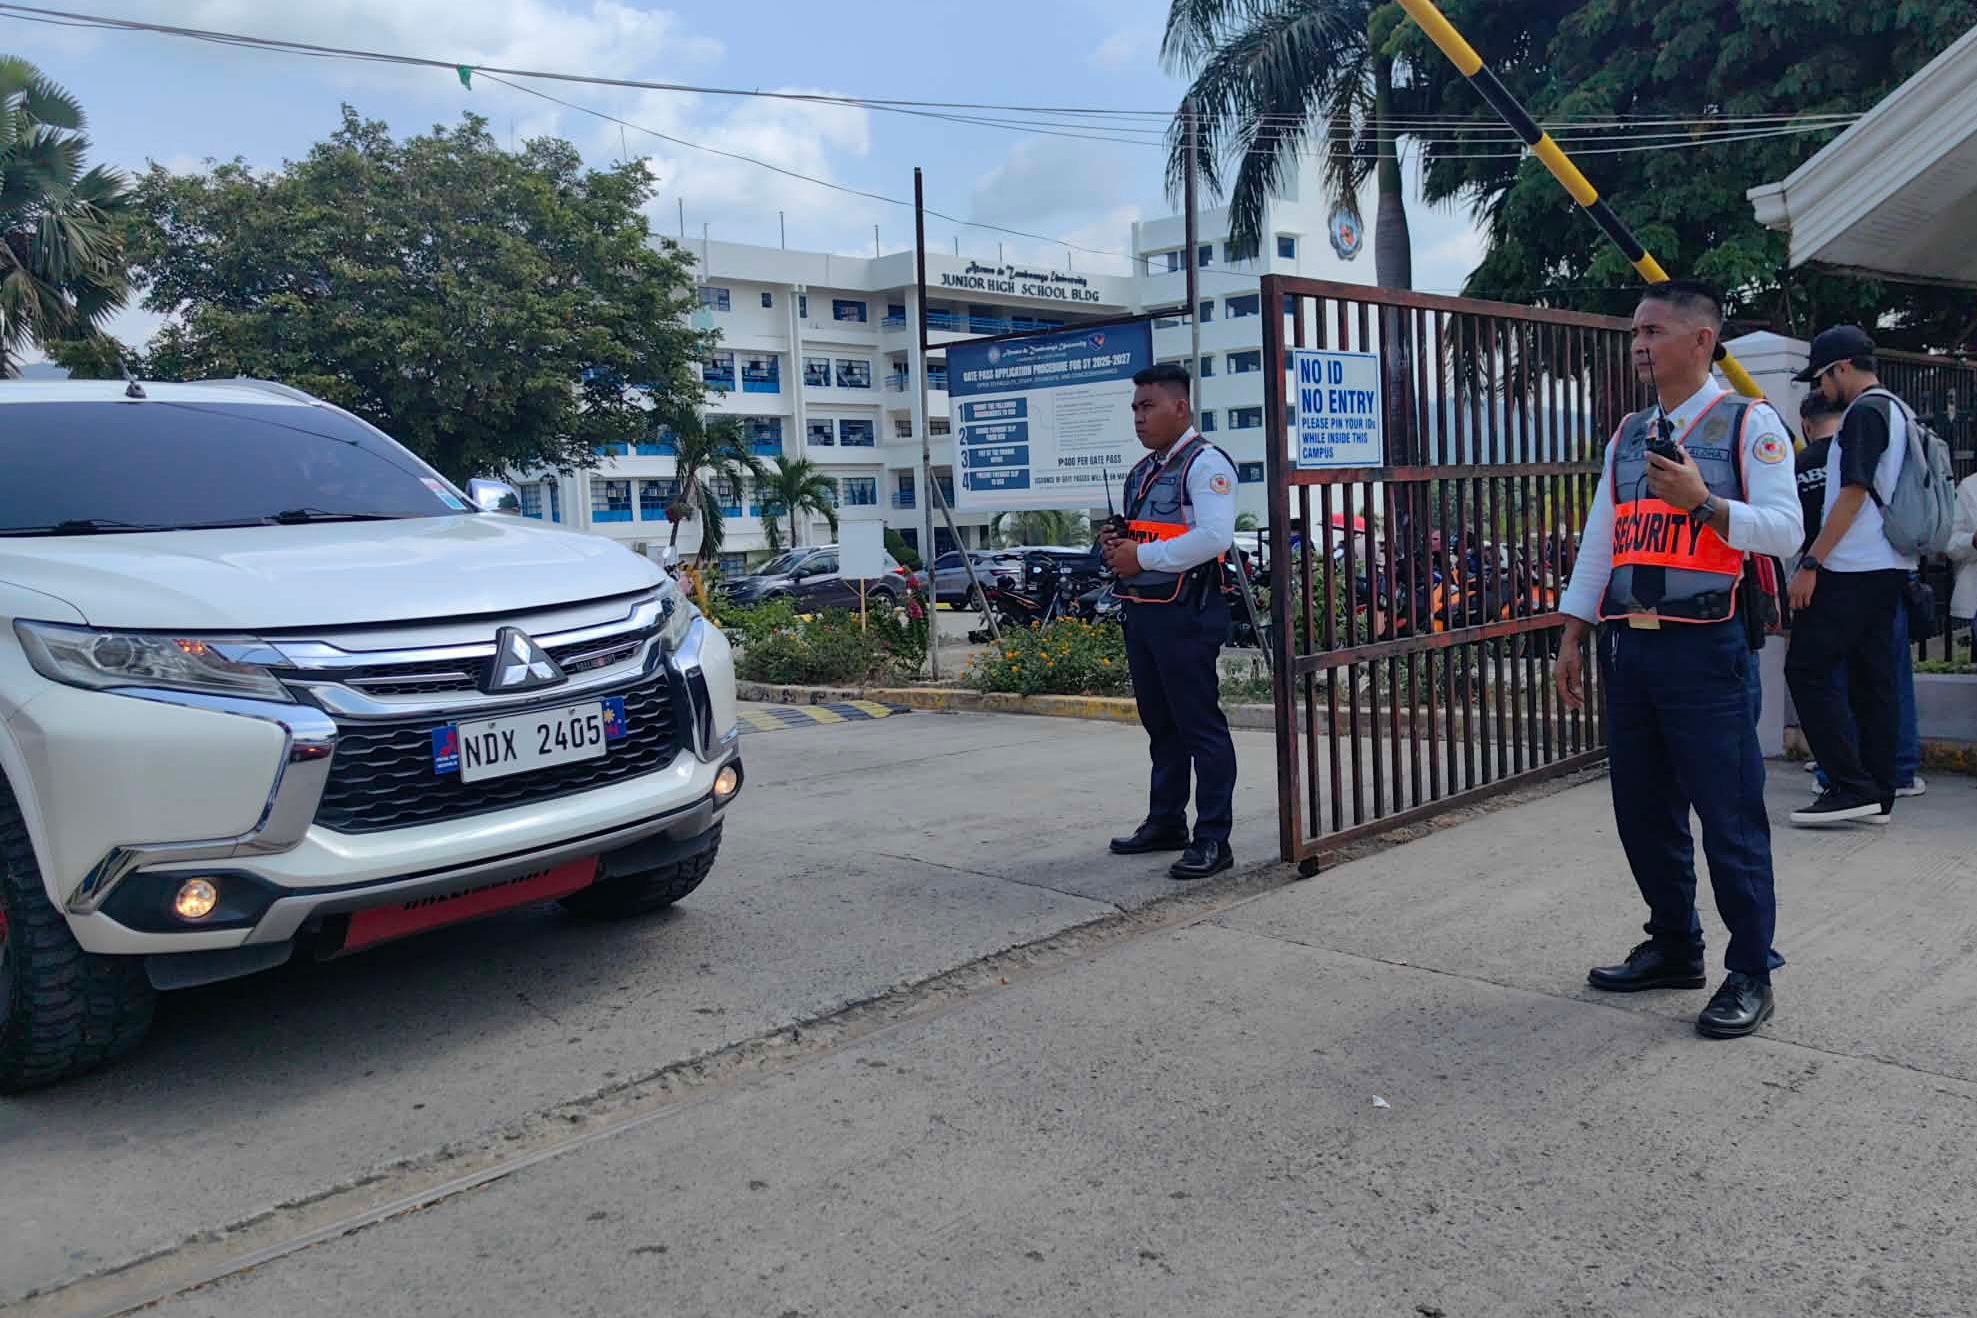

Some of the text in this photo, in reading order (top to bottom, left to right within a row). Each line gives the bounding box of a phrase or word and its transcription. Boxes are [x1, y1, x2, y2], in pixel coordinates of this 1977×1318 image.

[941, 273, 1099, 302] JUNIOR HIGH SCHOOL BLDG
[1301, 359, 1342, 384] NO ID
[1302, 388, 1374, 414] NO ENTRY
[1302, 418, 1328, 429] PLEASE
[1331, 418, 1342, 429] PIN
[1345, 419, 1362, 429] YOUR
[960, 427, 966, 445] 2
[1303, 432, 1368, 444] WHILE INSIDE THIS
[961, 451, 968, 468] 3
[1077, 456, 1088, 466] PER
[1090, 455, 1104, 465] GATE
[1106, 454, 1122, 464] PASS
[1303, 447, 1334, 459] CAMPUS
[963, 472, 969, 490] 4
[1613, 513, 1703, 556] SECURITY
[464, 715, 601, 768] NDX 2405
